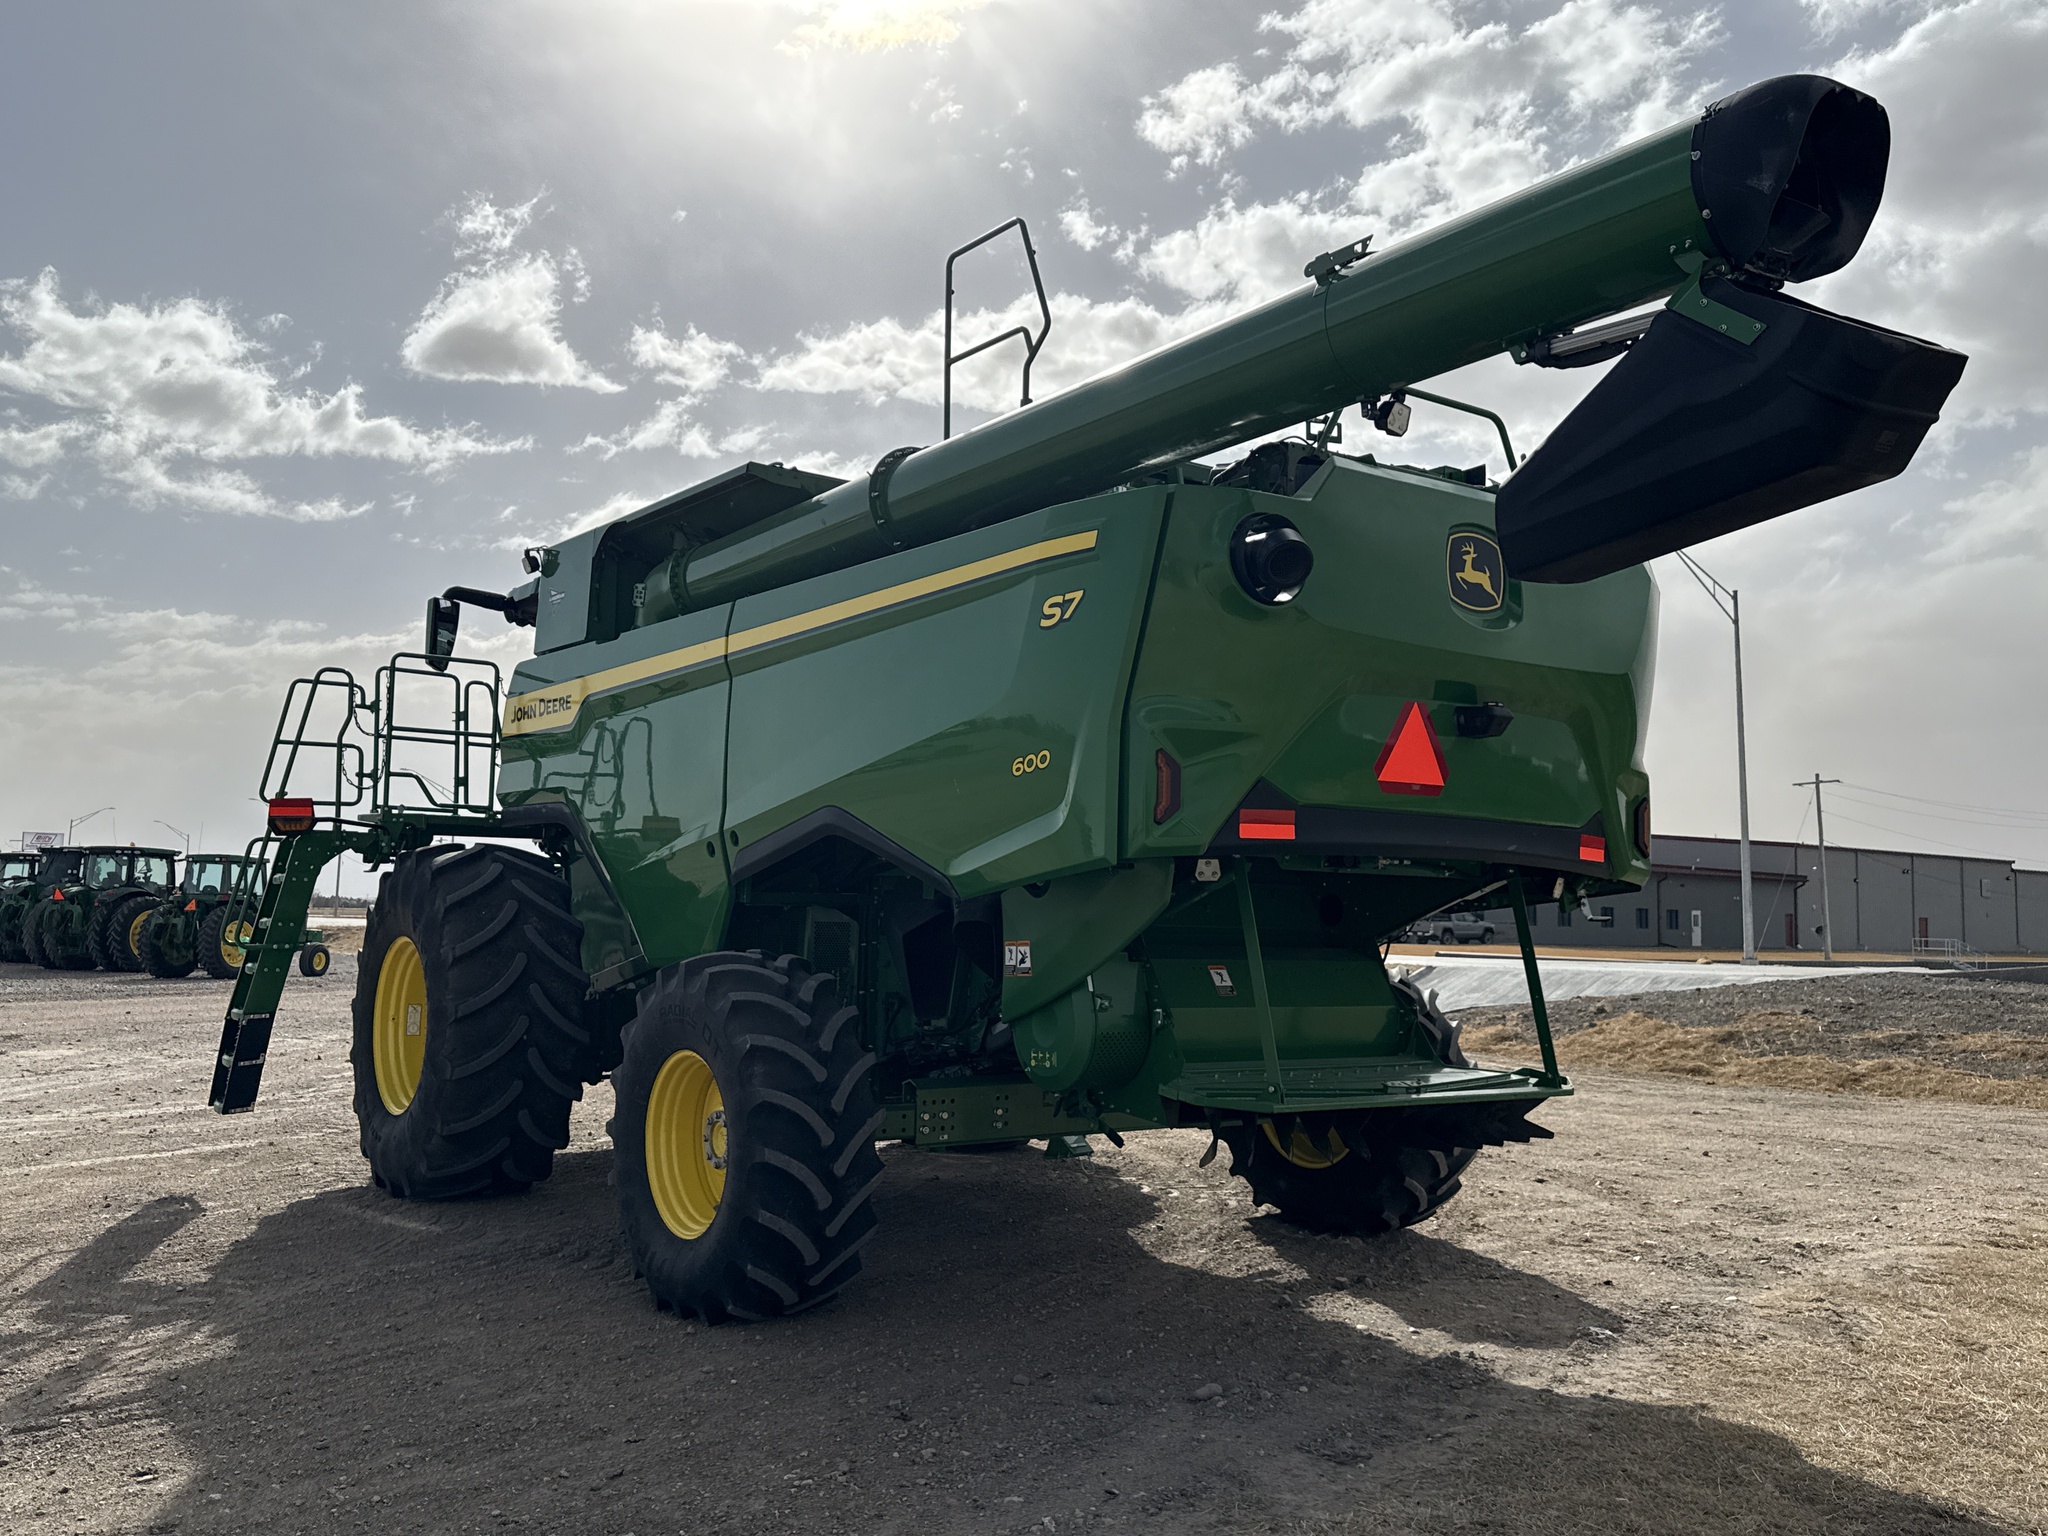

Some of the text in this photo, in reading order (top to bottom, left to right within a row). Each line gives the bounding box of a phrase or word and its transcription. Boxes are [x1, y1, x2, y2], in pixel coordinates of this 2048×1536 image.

[1039, 589, 1085, 629] S7
[510, 694, 572, 724] JOHN DEERE
[1011, 750, 1051, 777] 600
